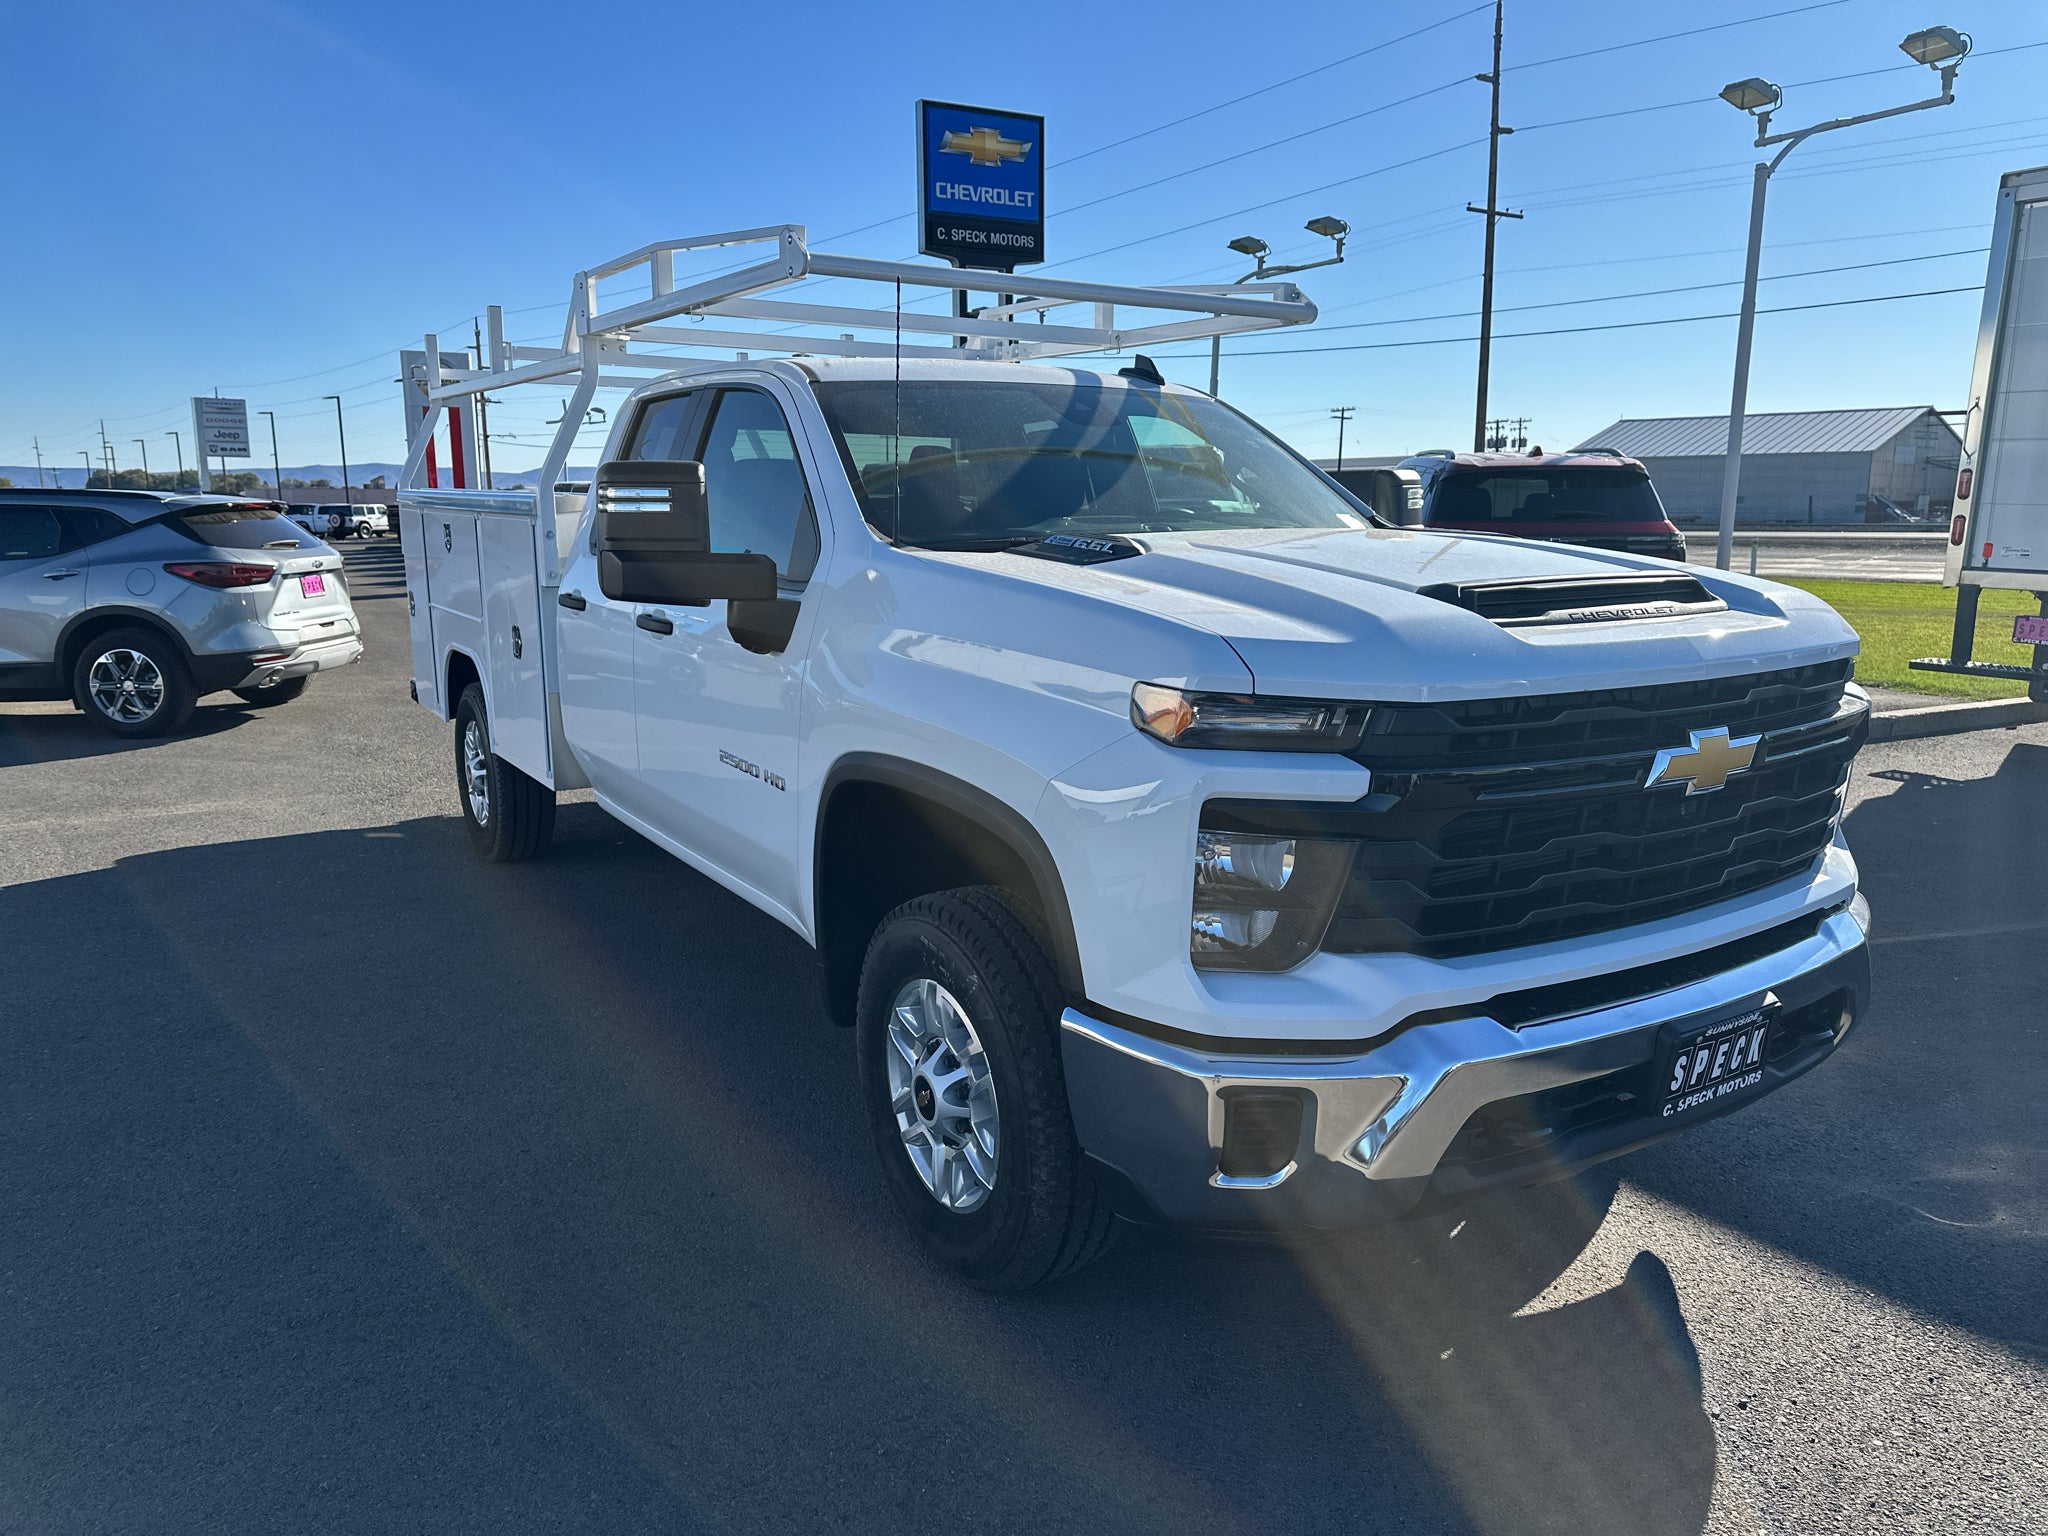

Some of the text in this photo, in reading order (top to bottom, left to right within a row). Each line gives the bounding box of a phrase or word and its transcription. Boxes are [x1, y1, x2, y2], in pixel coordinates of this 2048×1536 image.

[935, 181, 1035, 208] CHEVROLET
[937, 227, 1035, 248] C. SPECK MOTORS
[213, 430, 240, 440] Jeep
[1568, 606, 1674, 621] CHEVROLET
[719, 748, 786, 792] 2500 HD
[1705, 1012, 1760, 1037] SUNNYSIDE
[1670, 1027, 1765, 1091] SPECK
[1662, 1070, 1763, 1117] C. SPECK MOTORS
